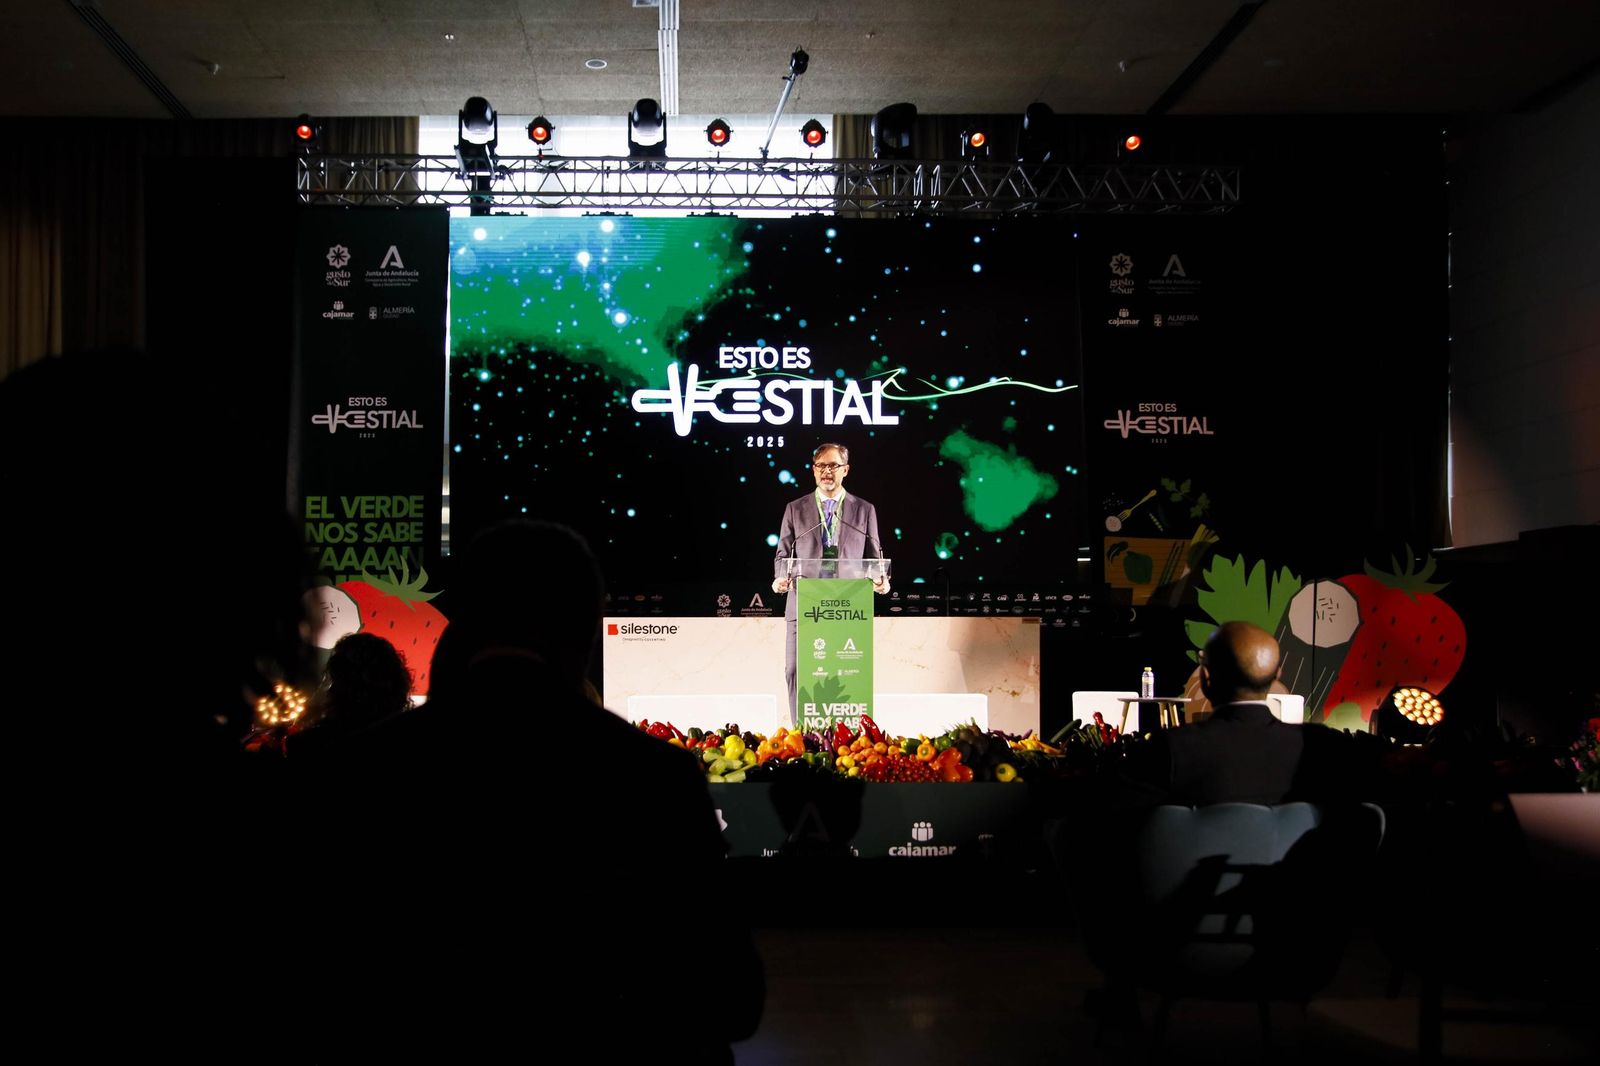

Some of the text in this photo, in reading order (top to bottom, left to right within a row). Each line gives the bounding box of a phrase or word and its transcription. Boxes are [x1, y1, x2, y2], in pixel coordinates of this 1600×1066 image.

[322, 309, 355, 319] cajamar
[383, 305, 415, 314] ALMERÍA
[1108, 318, 1140, 327] cajamar
[719, 346, 811, 369] ESTO ES
[348, 397, 388, 407] ESTO ES
[1138, 403, 1177, 413] ESTO ES
[747, 436, 785, 448] 2025
[305, 495, 424, 519] EL VERDE
[304, 521, 424, 543] NOS SABE
[820, 599, 851, 607] ESTO ES
[620, 623, 677, 635] silestone
[803, 703, 867, 716] EL VERDE
